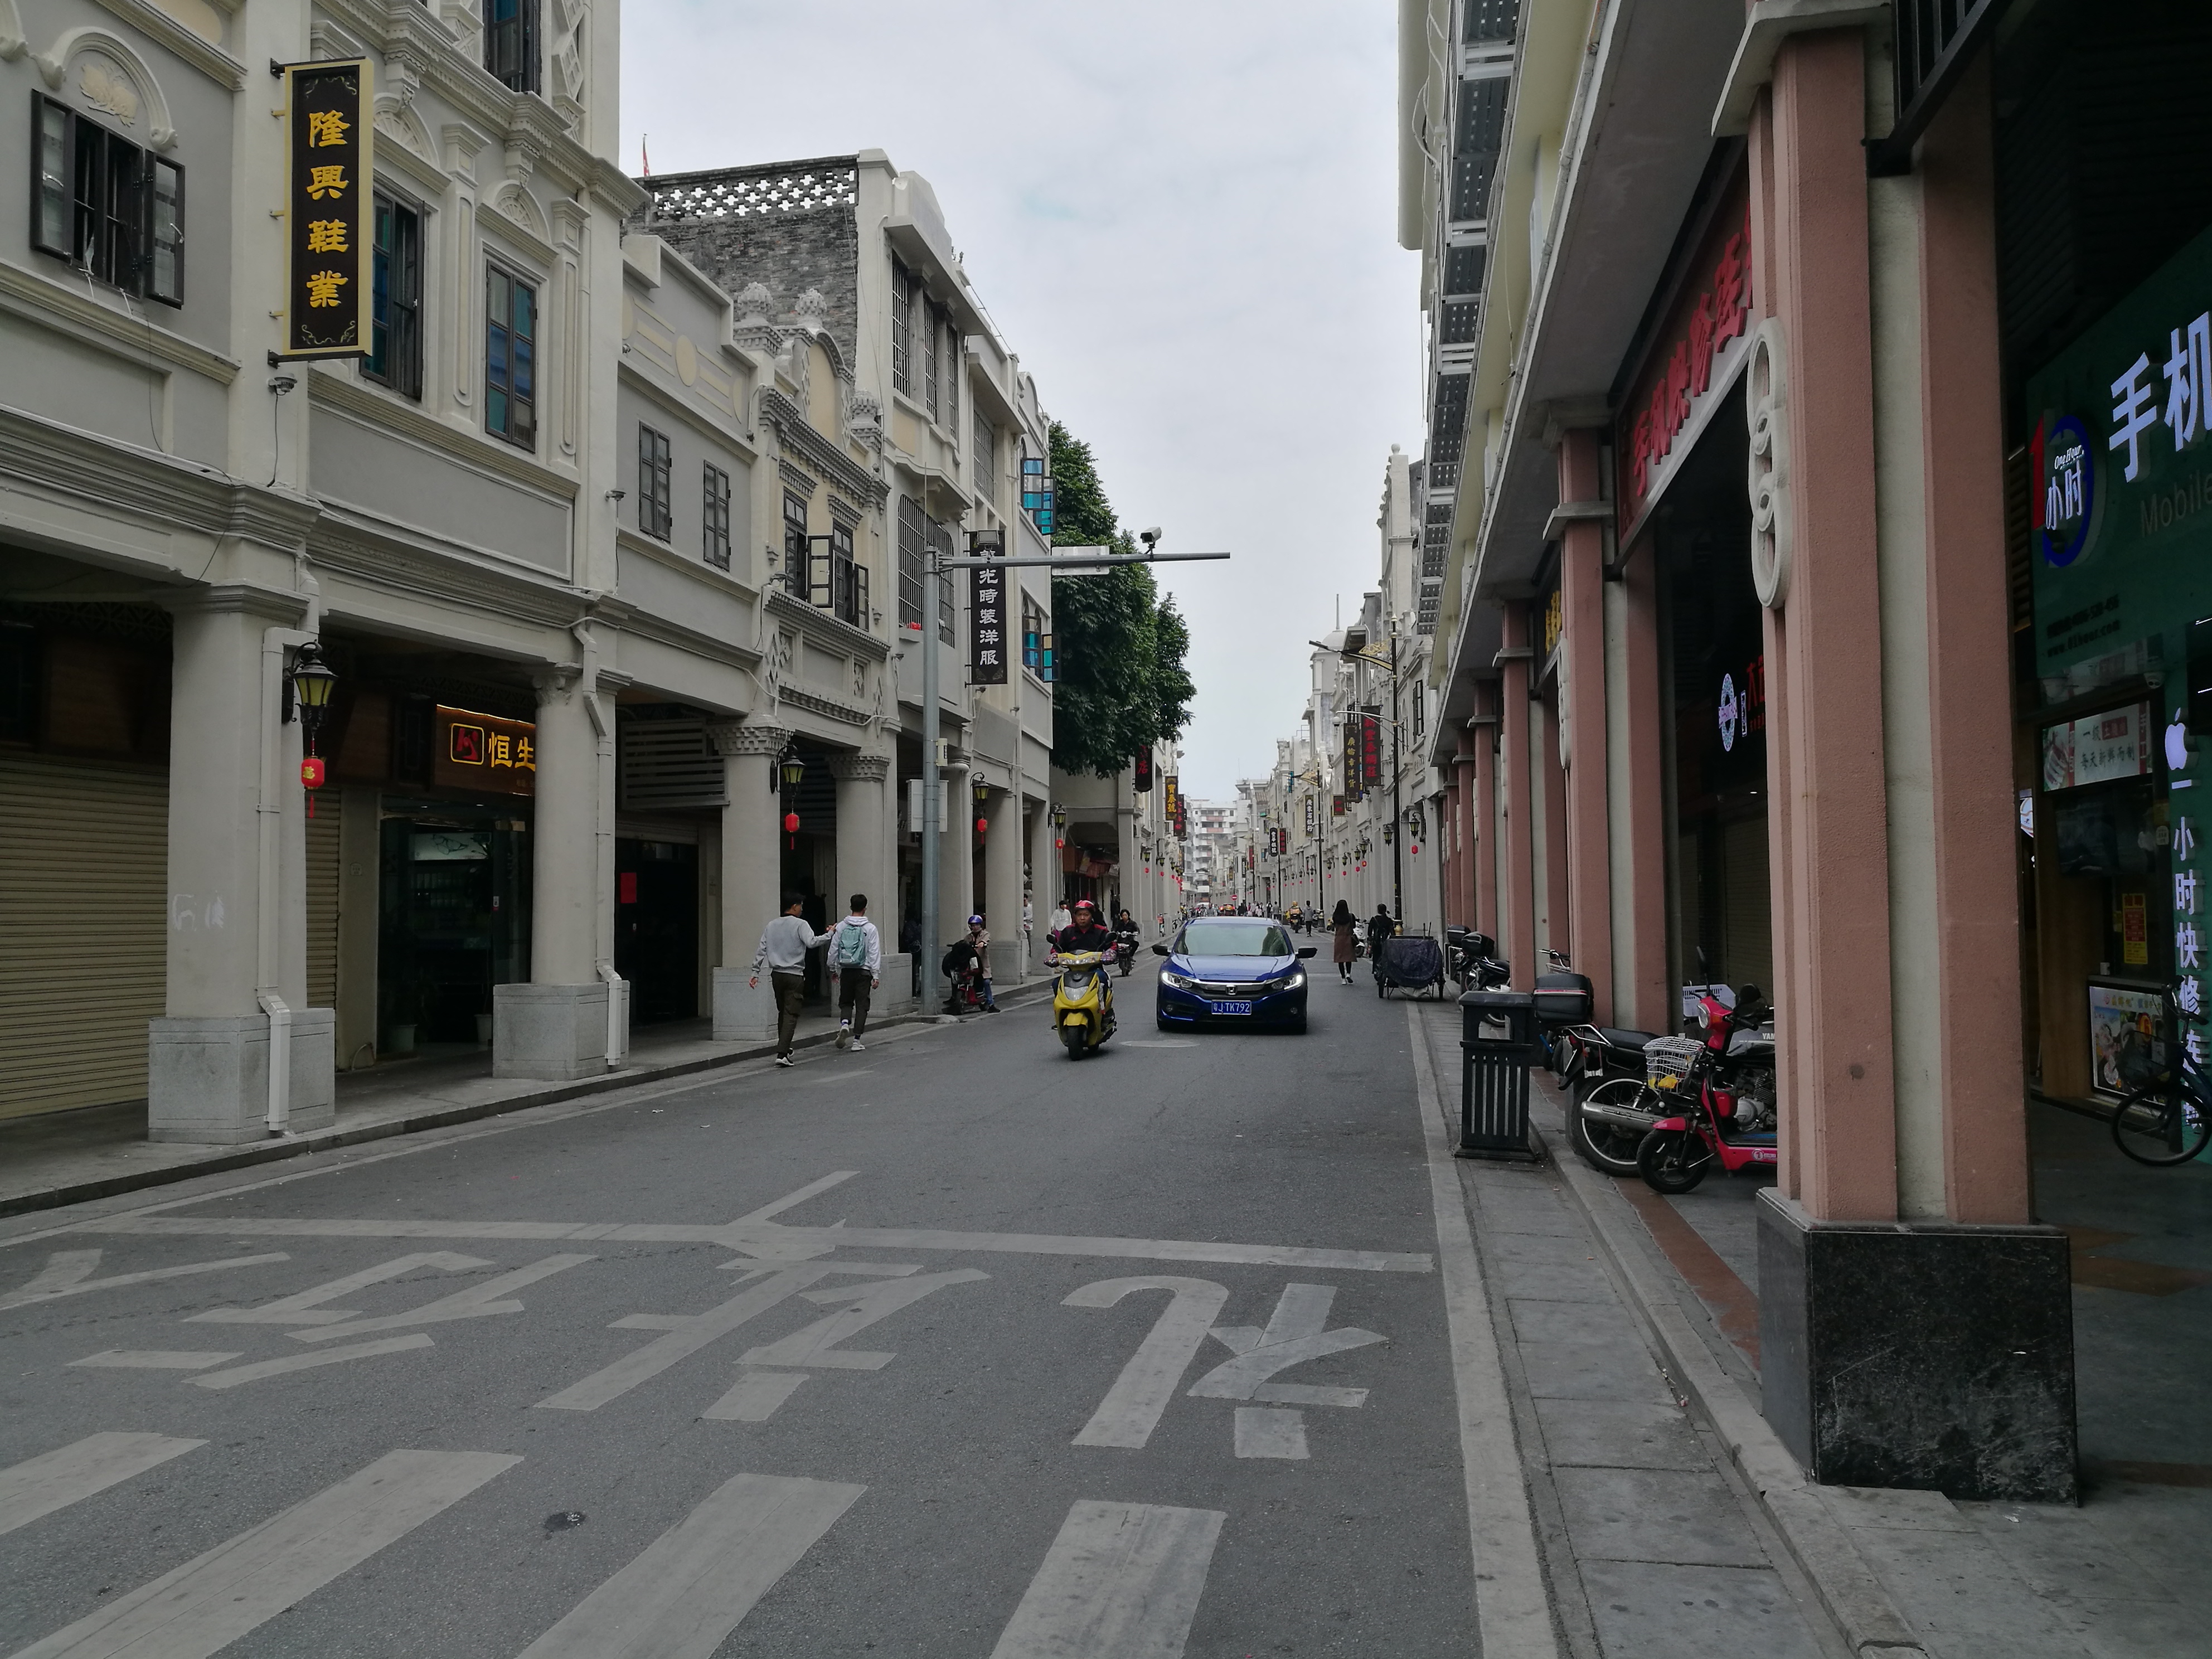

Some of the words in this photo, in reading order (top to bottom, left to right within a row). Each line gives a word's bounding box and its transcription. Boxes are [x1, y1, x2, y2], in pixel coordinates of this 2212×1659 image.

[306, 110, 351, 308] 隆興鞋業
[1633, 202, 1753, 497] 手机快修连
[2109, 311, 2212, 483] 手机
[2045, 459, 2083, 530] 小时
[488, 731, 536, 772] 恒生
